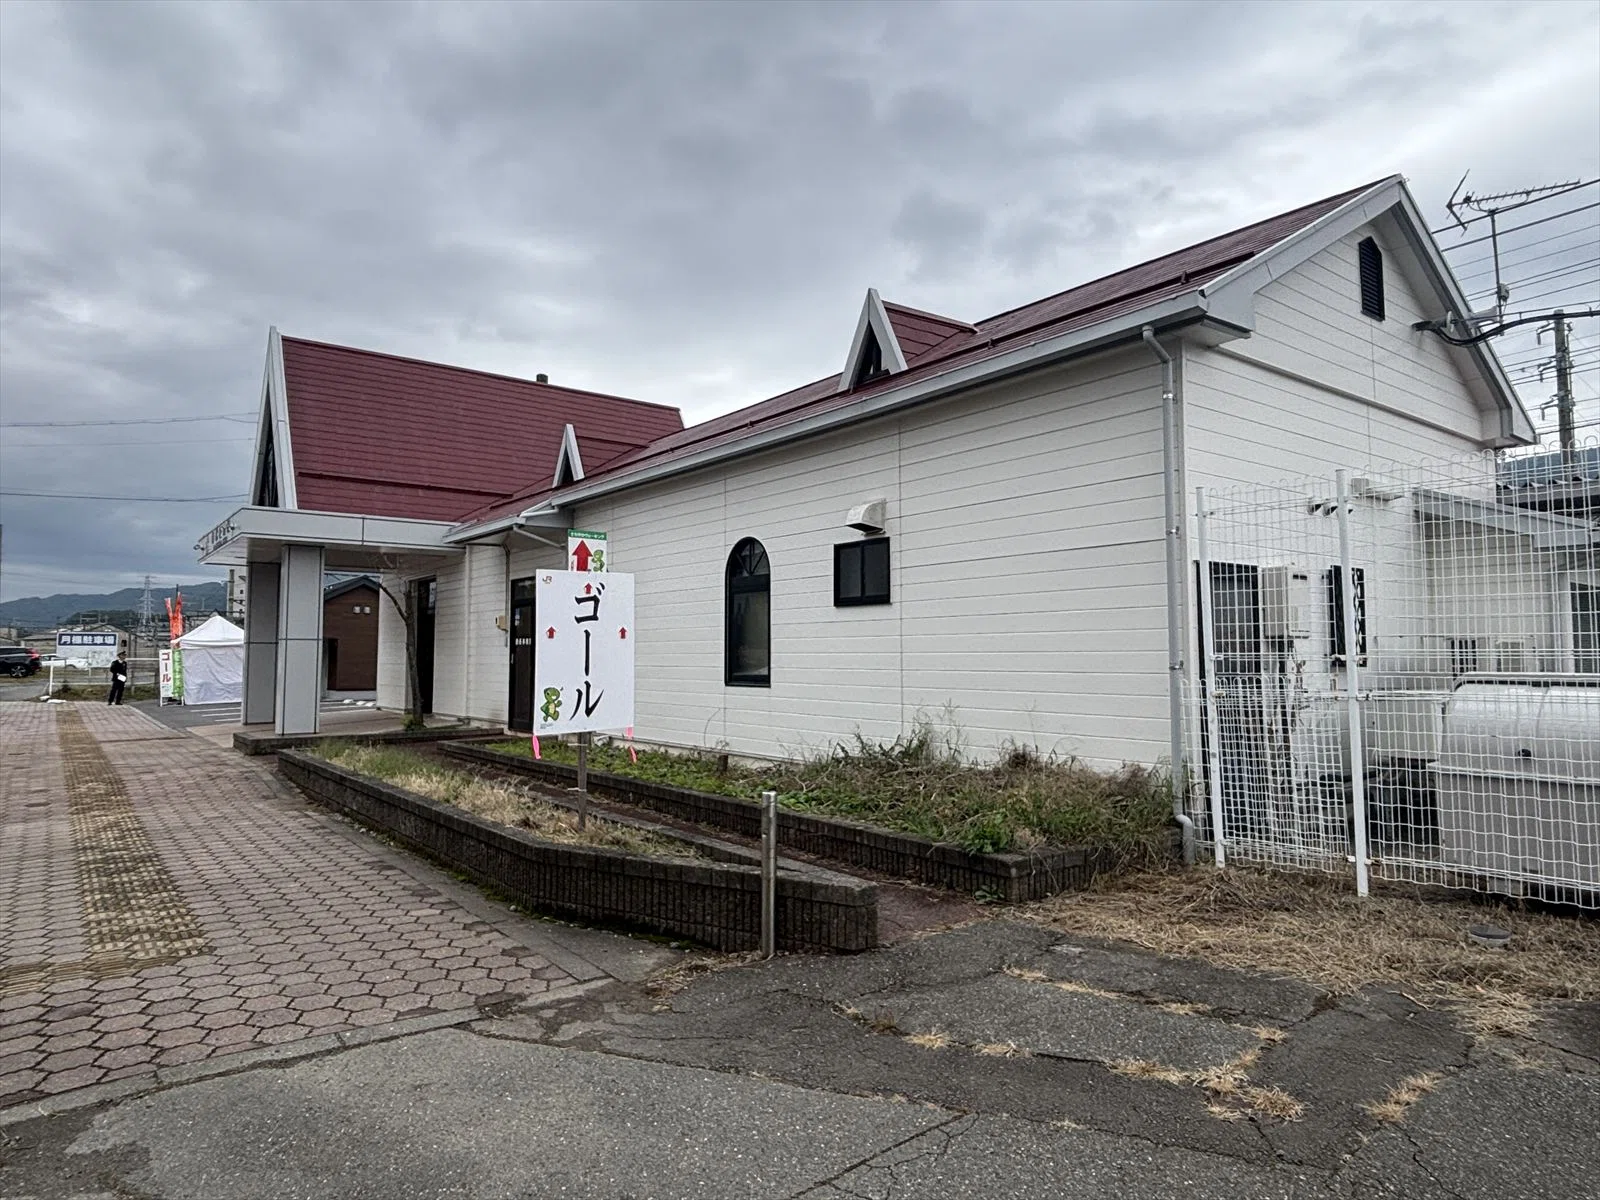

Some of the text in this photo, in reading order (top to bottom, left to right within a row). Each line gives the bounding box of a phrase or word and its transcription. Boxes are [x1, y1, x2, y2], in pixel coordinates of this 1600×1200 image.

[162, 652, 171, 682] ゴール
[569, 582, 605, 720] ゴール
